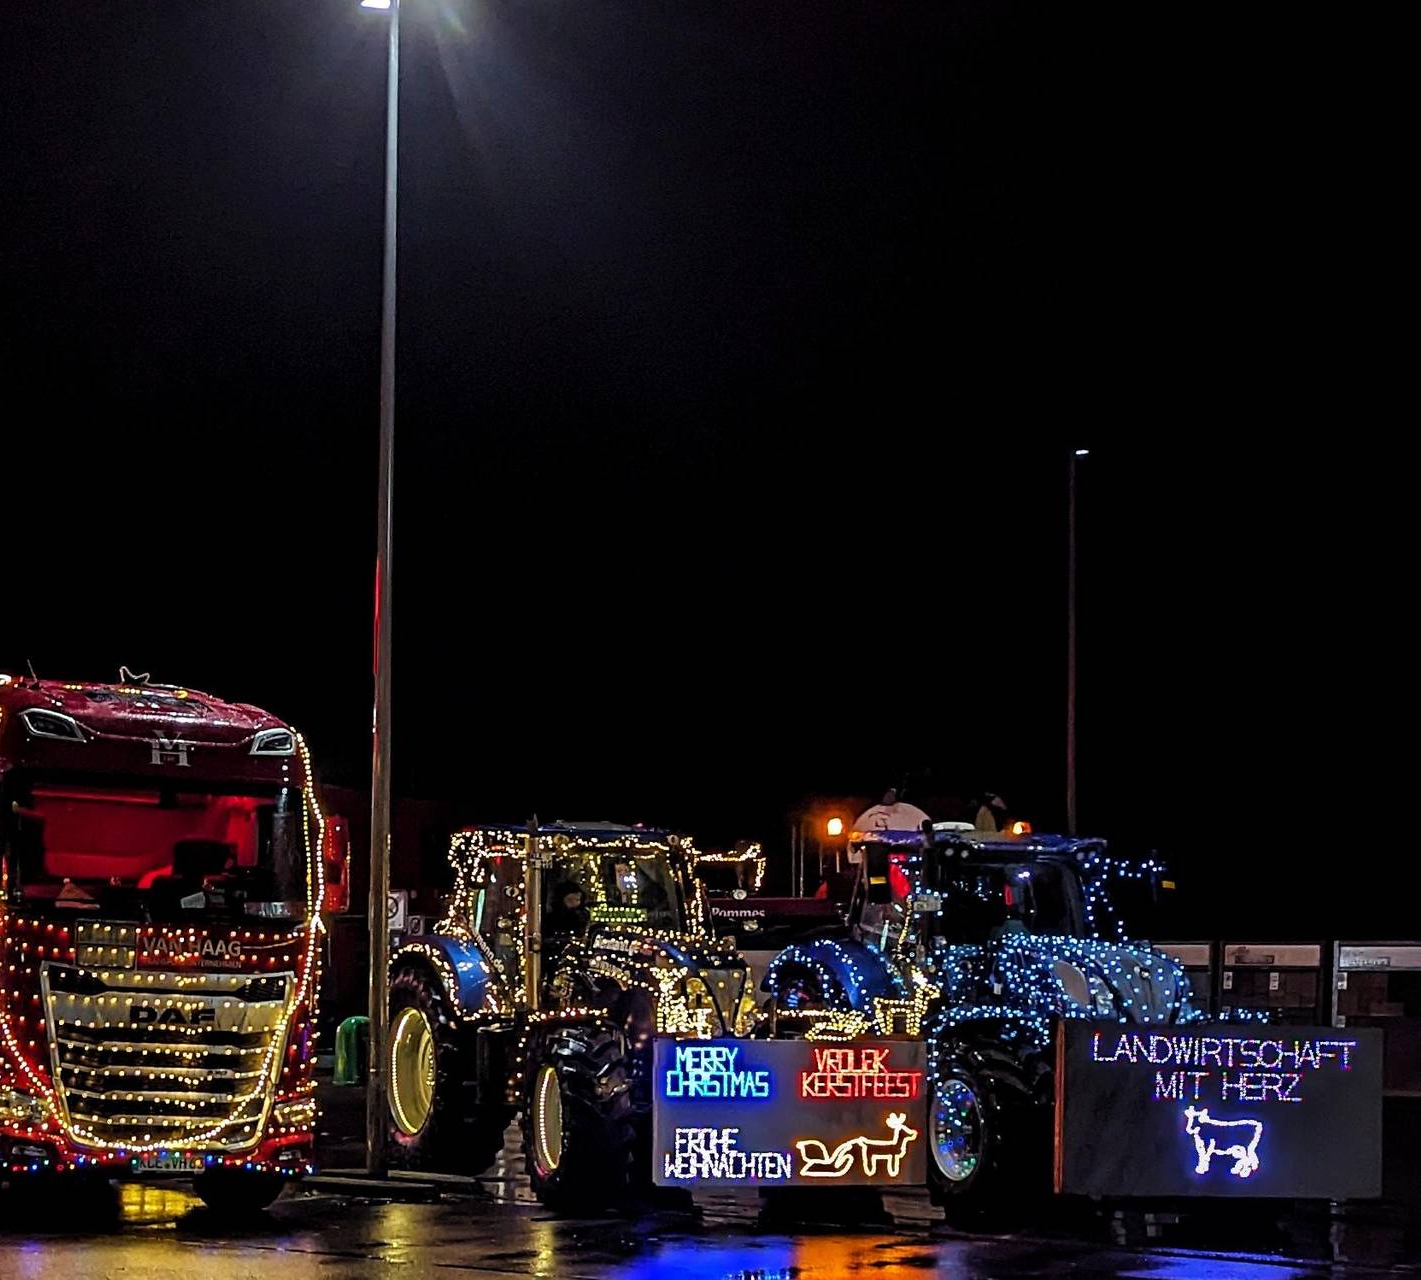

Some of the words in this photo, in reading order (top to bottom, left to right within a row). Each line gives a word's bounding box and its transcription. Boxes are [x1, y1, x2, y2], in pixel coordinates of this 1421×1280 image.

[711, 907, 766, 918] Pommes
[143, 937, 183, 953] VAN
[189, 939, 242, 956] HAAG
[130, 1005, 215, 1025] DAF
[675, 1046, 739, 1073] MERRY
[1092, 1031, 1357, 1070] LANDWIRTSCHAFT
[666, 1071, 770, 1098] CHRISTMAS
[801, 1072, 922, 1097] KERSTFEEST
[1155, 1070, 1210, 1100] MIT
[1221, 1071, 1303, 1102] HERZ
[674, 1128, 739, 1154] FROHE
